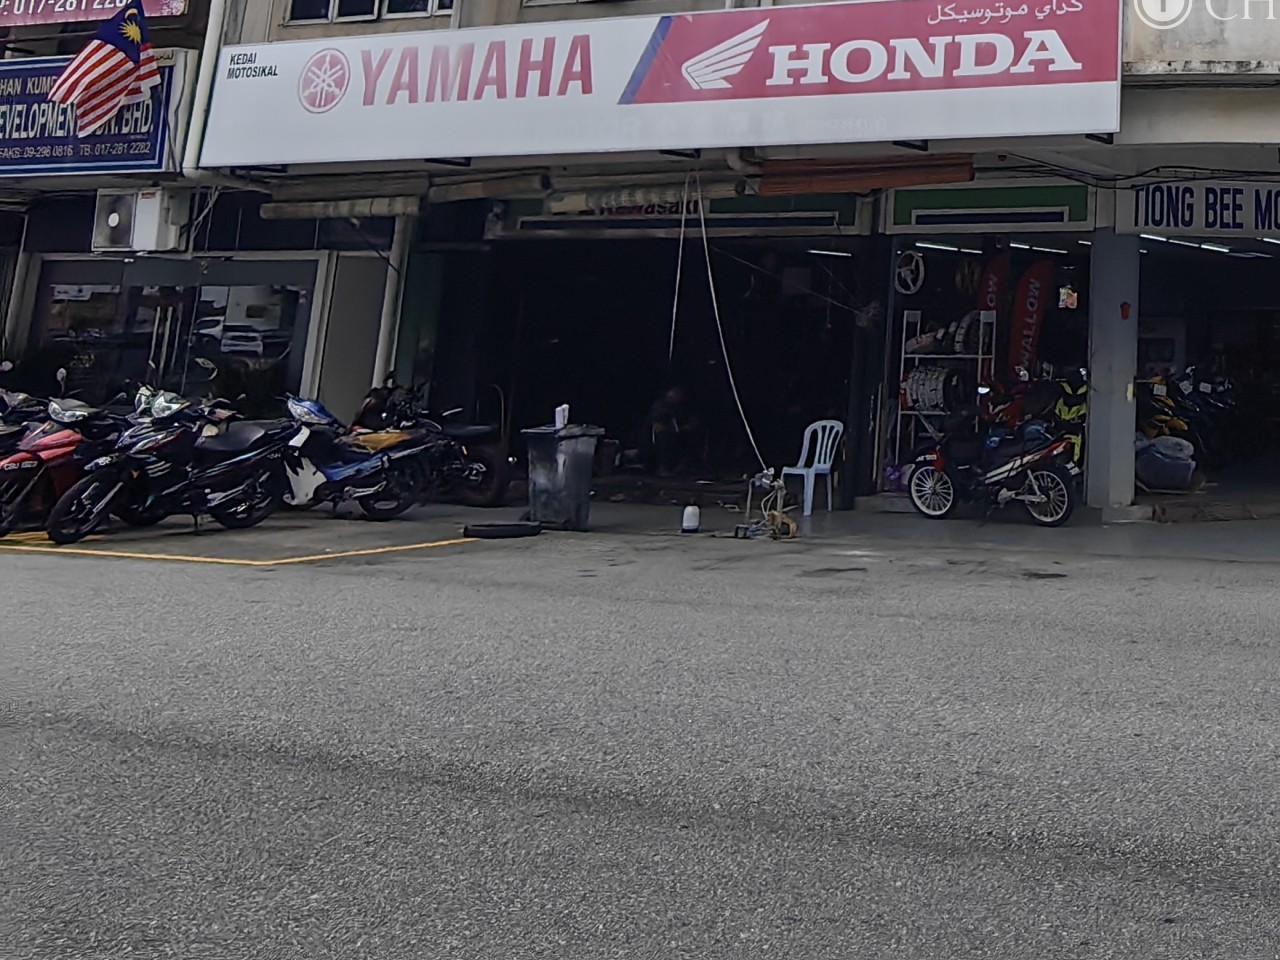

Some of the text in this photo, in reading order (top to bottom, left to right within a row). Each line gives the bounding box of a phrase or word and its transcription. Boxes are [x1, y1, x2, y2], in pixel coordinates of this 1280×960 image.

[226, 64, 278, 80] MOTOSIKAL
[229, 53, 257, 66] KEDAI
[361, 34, 593, 106] YAMAHA
[766, 29, 1083, 86] HONDA
[1134, 185, 1195, 228] TIONG
[1204, 187, 1244, 229] BEE
